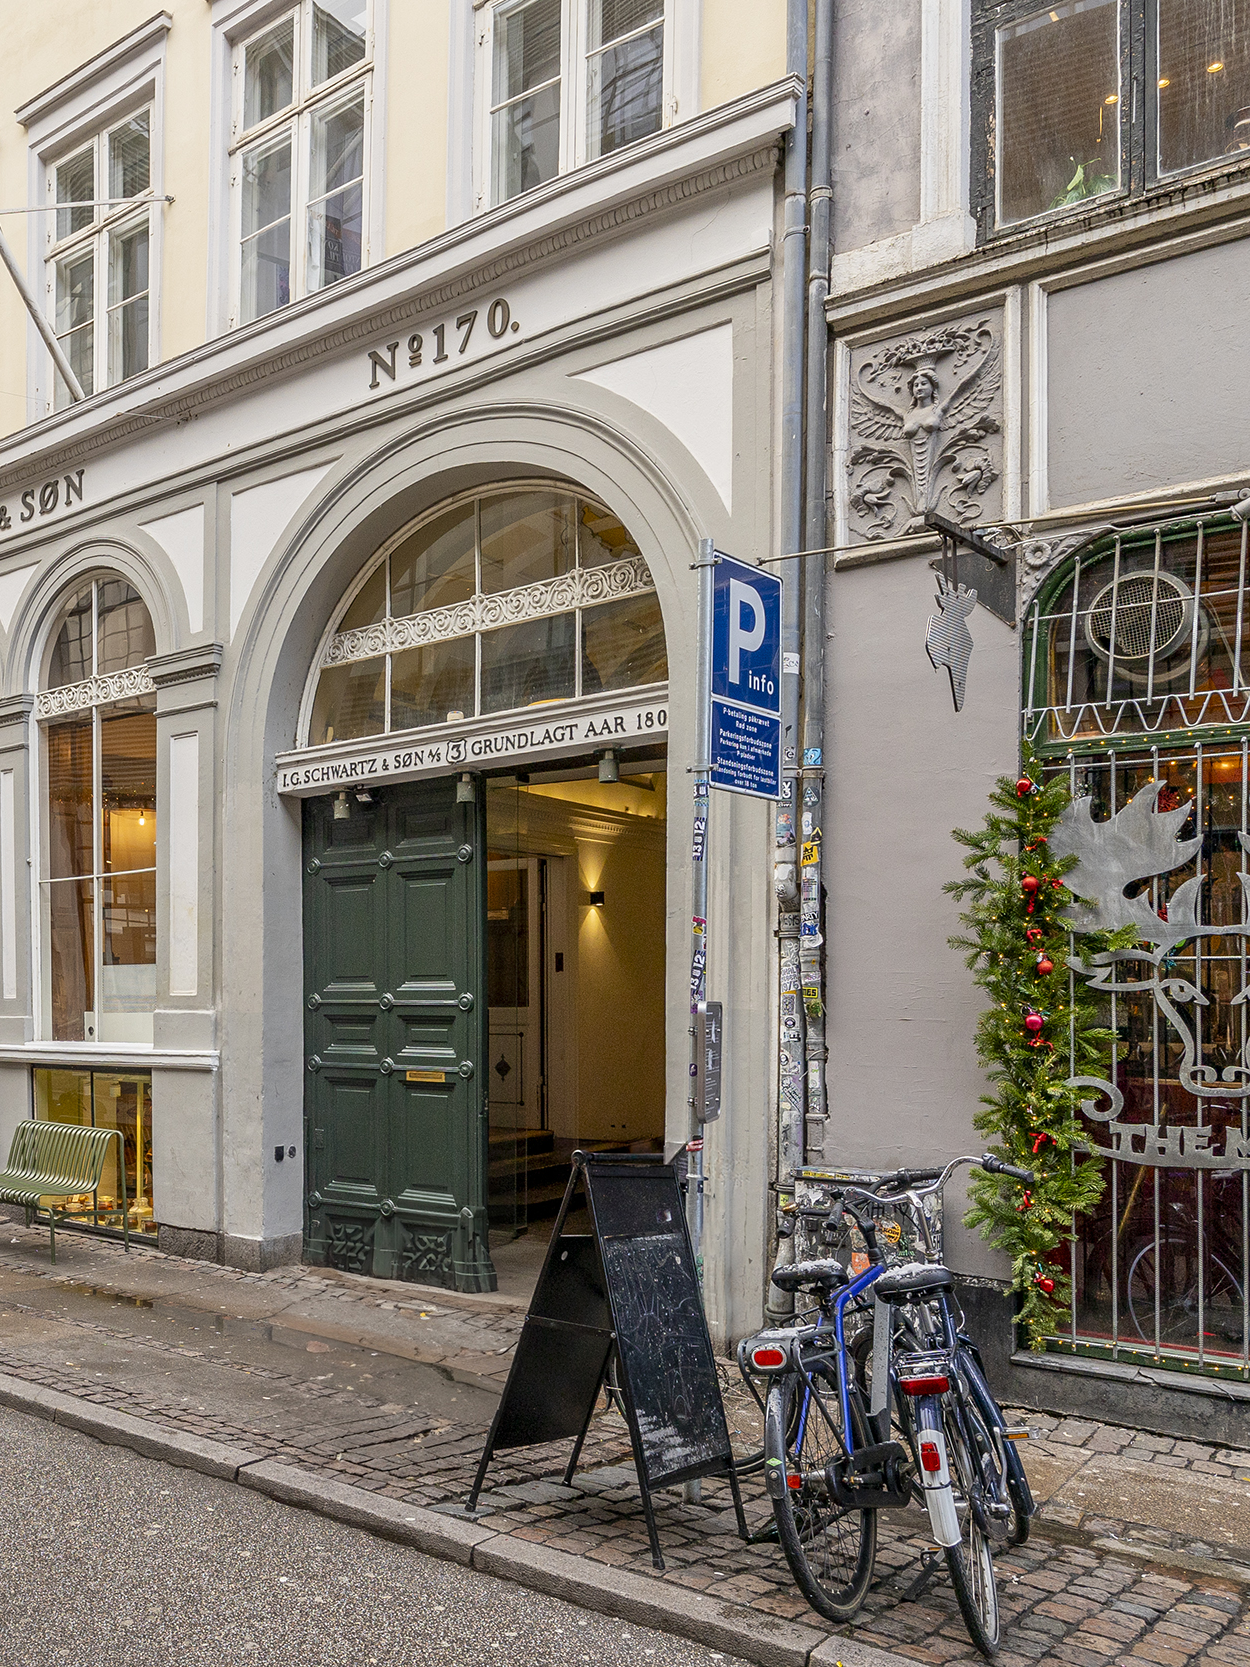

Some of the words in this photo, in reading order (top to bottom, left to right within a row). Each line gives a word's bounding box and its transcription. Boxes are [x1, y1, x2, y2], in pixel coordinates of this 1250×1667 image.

[20, 468, 86, 523] SØN
[728, 577, 766, 684] P
[748, 669, 775, 696] info
[719, 728, 773, 750] Parkeringsforbudszone
[746, 724, 758, 734] zone
[303, 757, 378, 784] SCHWARTZ
[381, 758, 391, 770] &
[394, 749, 425, 769] SØN
[470, 722, 579, 757] GRUNDLAGT
[584, 715, 628, 738] AAR
[1109, 1120, 1214, 1158] THE
